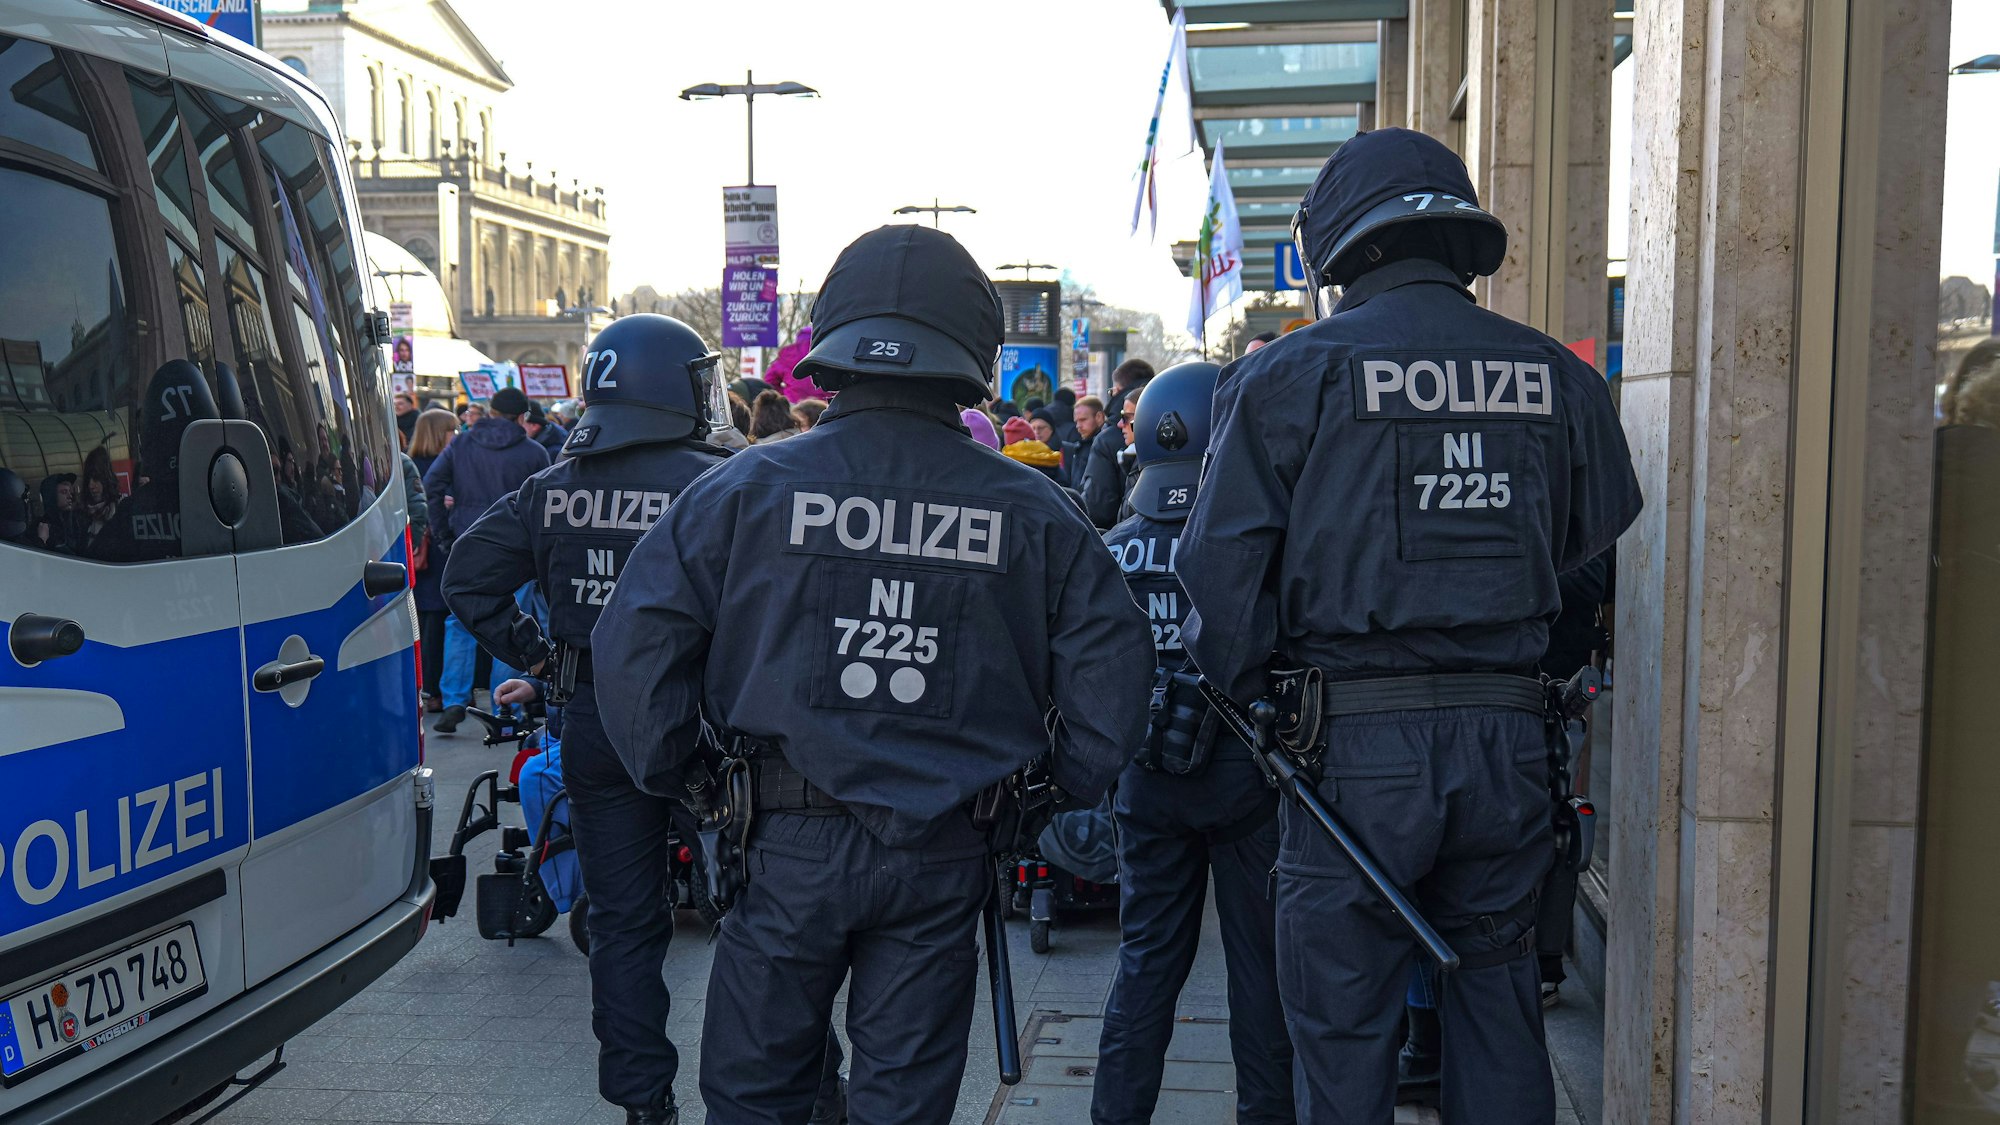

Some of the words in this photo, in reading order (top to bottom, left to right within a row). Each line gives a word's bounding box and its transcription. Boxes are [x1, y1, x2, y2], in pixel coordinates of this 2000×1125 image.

[729, 281, 748, 291] WIR
[750, 281, 764, 291] UN
[732, 271, 766, 281] HOLEN
[726, 302, 772, 312] ZUKUNFT
[741, 291, 758, 301] DIE
[870, 341, 900, 357] 25
[585, 349, 617, 391] 72
[1363, 360, 1552, 415] POLIZEI
[572, 429, 590, 443] 25
[1443, 432, 1483, 469] NI
[1167, 488, 1188, 505] 25
[1413, 472, 1511, 511] 7225
[789, 491, 1003, 566] POLIZEI
[587, 549, 614, 576] NI
[1107, 538, 1180, 573] POLI
[571, 578, 616, 606] 722
[869, 578, 915, 620] NI
[1148, 592, 1178, 620] NI
[834, 617, 939, 664] 7225
[1151, 624, 1183, 651] 22
[0, 767, 223, 905] OLIZEI
[27, 993, 59, 1050] H
[75, 967, 125, 1027] ZD
[127, 940, 187, 1002] 748
[96, 1020, 139, 1046] MOSOLF
[4, 1045, 15, 1062] D
